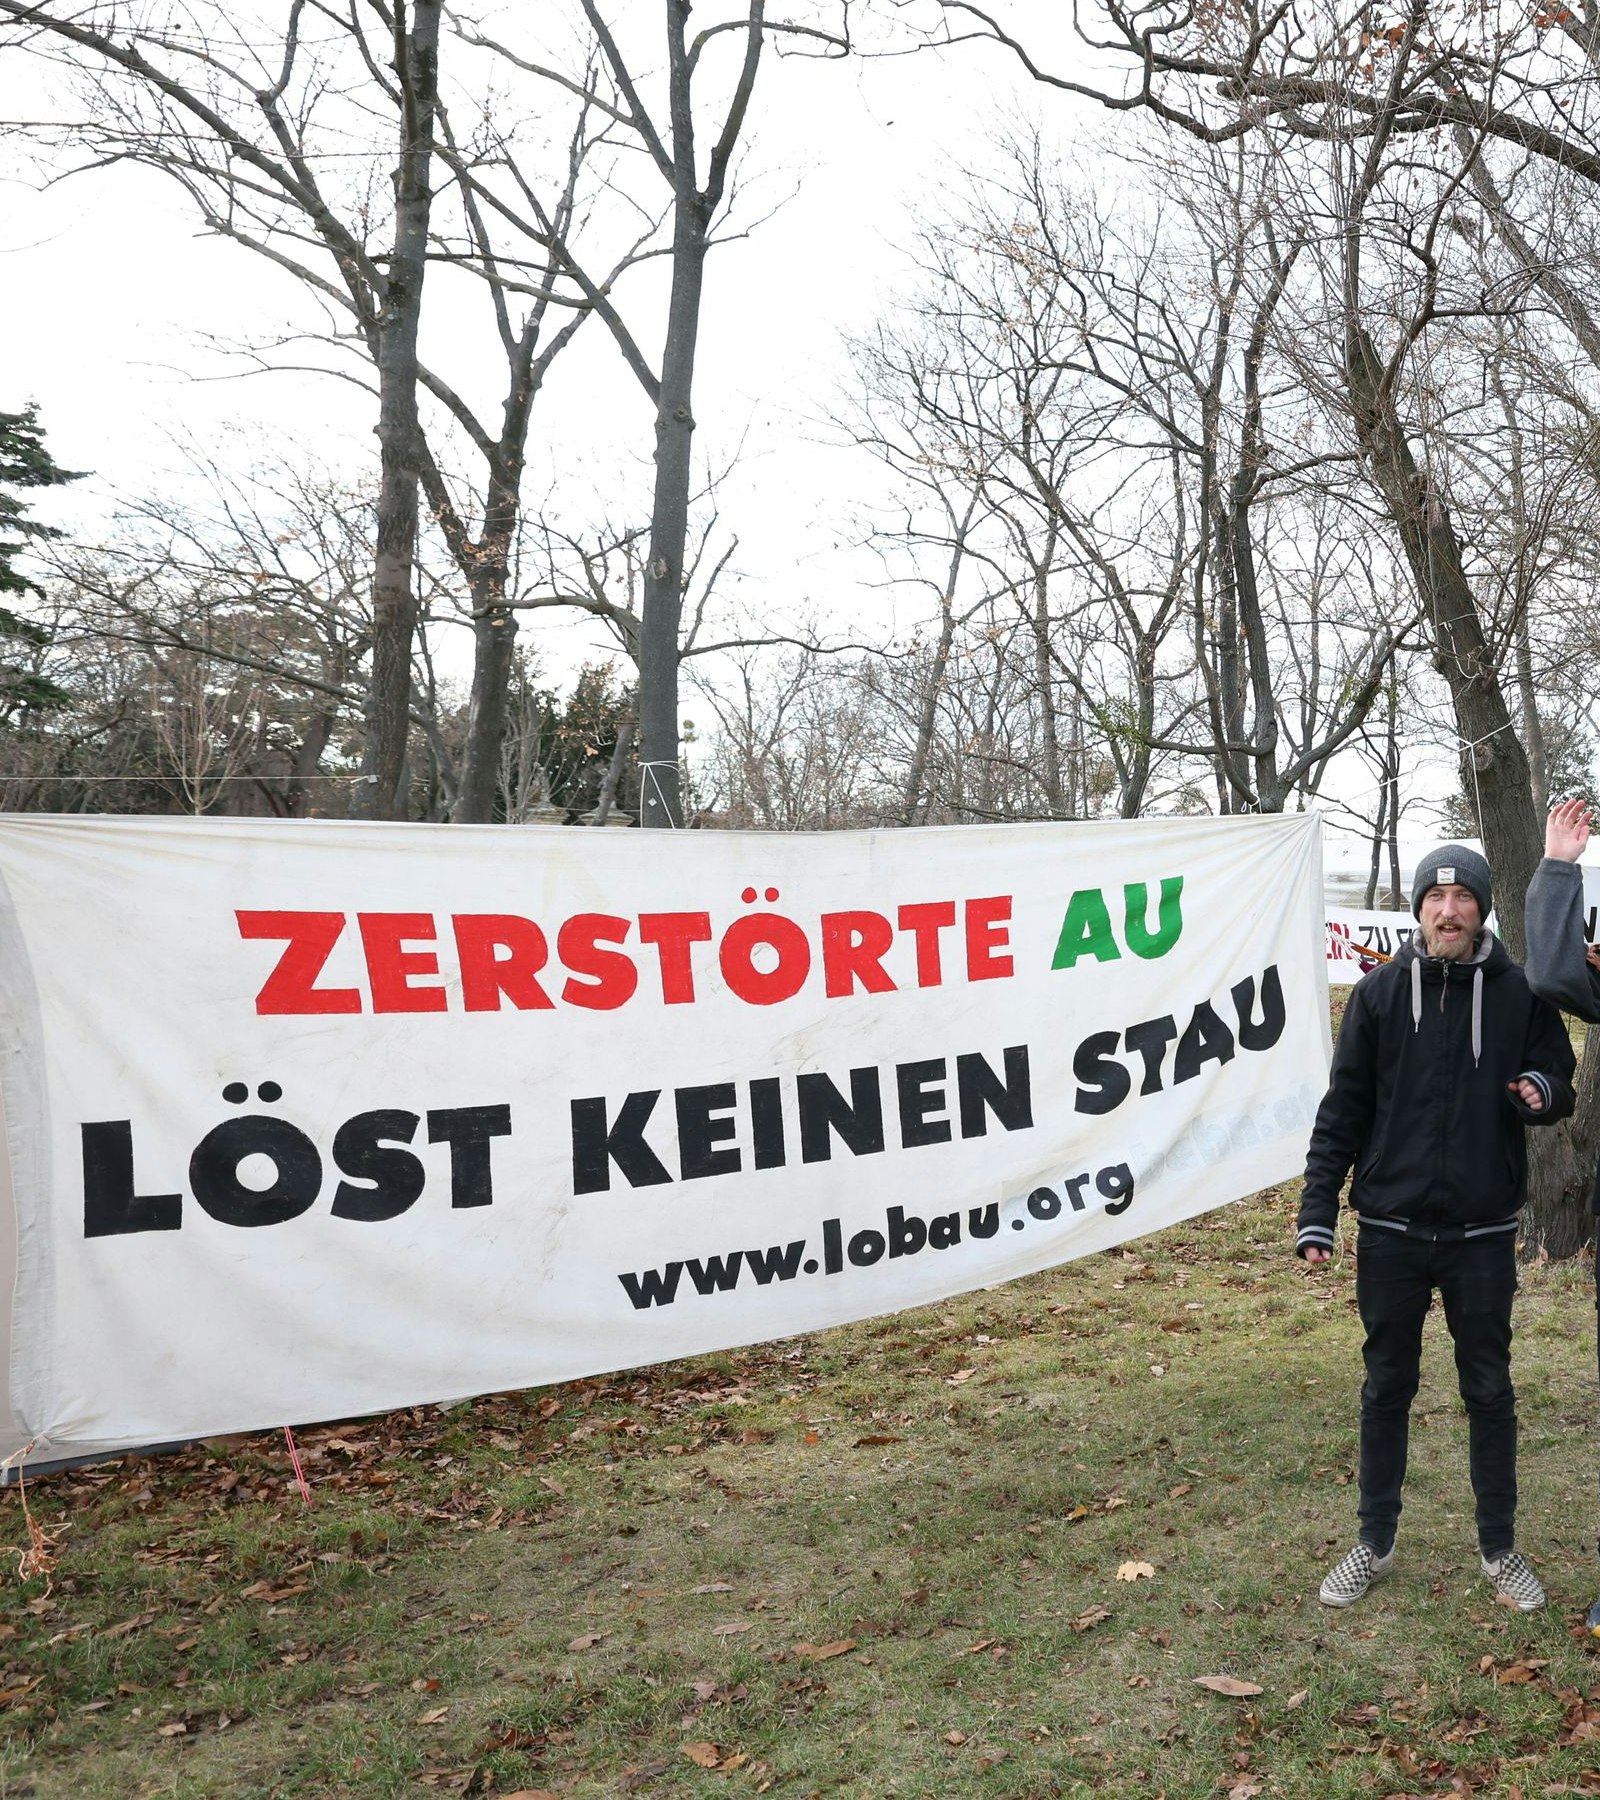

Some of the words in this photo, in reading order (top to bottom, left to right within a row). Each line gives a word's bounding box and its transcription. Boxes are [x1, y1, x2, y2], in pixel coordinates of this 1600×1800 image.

[234, 887, 1014, 1015] ZERSTÖRTE
[1051, 875, 1184, 970] AU
[81, 1080, 512, 1238] LÖST
[571, 1045, 1034, 1195] KEINEN
[1073, 964, 1286, 1117] STAU
[617, 1162, 1135, 1310] www.lobau.org
